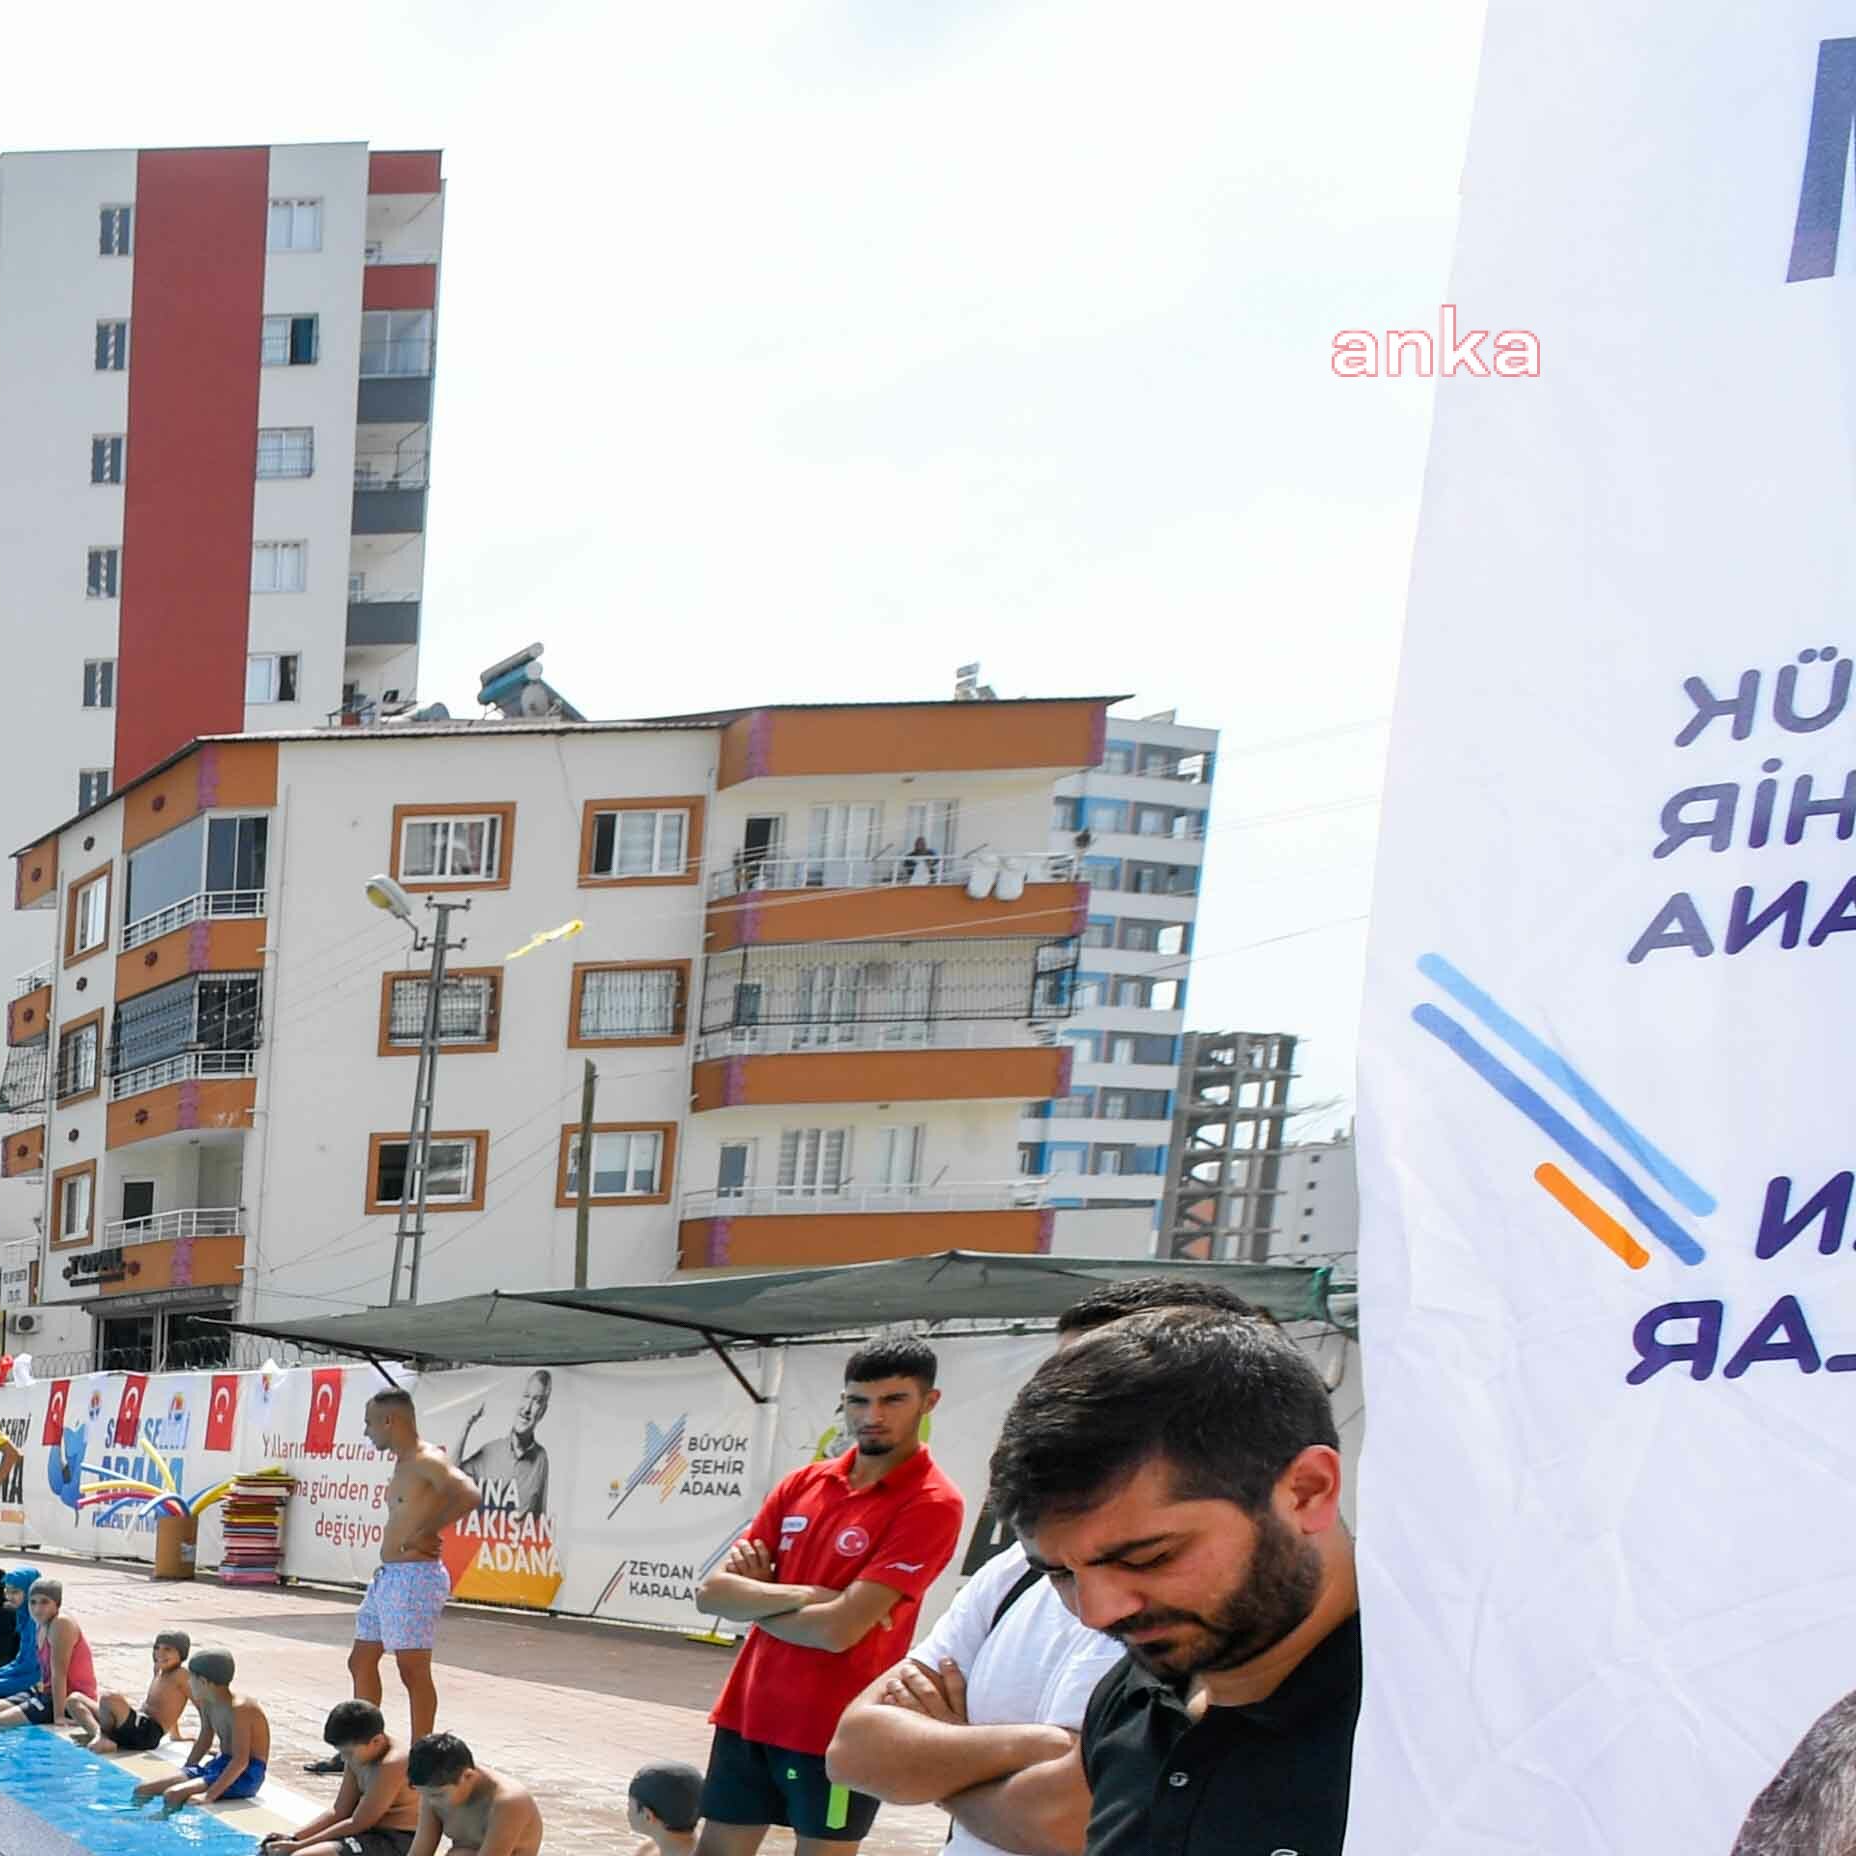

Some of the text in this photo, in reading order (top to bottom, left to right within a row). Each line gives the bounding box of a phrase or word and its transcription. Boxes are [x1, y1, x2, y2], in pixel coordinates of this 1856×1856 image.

[688, 1433, 749, 1452] BÜYÜK
[690, 1457, 745, 1478] ŞEHİR
[311, 1473, 369, 1504] günden
[680, 1481, 741, 1496] ADANA
[477, 1540, 564, 1577] ADANA
[628, 1560, 694, 1580] ZEYDAN
